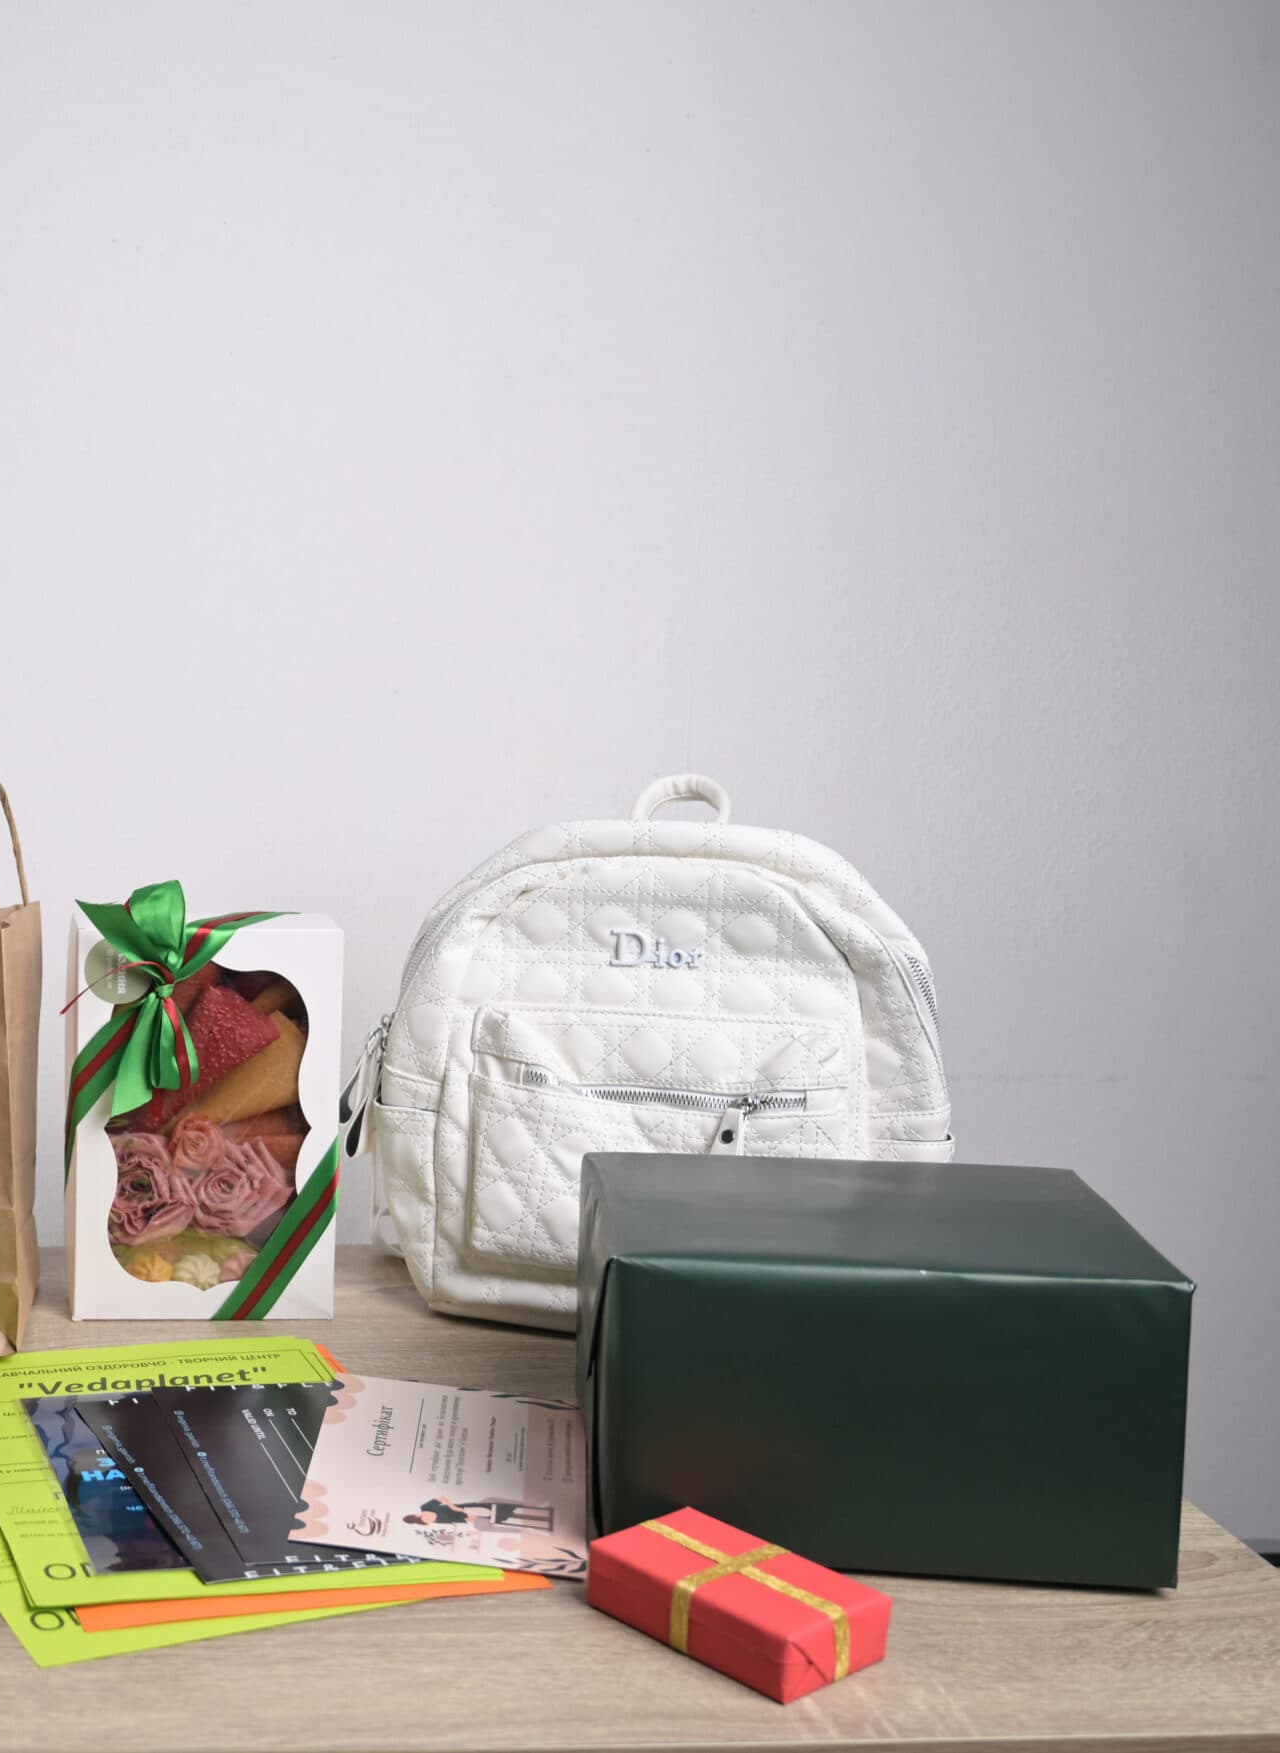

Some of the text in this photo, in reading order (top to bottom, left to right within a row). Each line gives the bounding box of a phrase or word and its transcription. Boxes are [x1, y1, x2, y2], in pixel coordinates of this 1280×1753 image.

[609, 929, 702, 969] Dior
[86, 1360, 167, 1372] ОЗДОРОВЧО
[177, 1354, 238, 1365] ТВОРЧИЙ
[241, 1352, 281, 1361] ЦЕНТР
[18, 1366, 267, 1396] "Vedaplanet"
[286, 1407, 297, 1416] TO
[366, 1405, 395, 1456] Сертифікат
